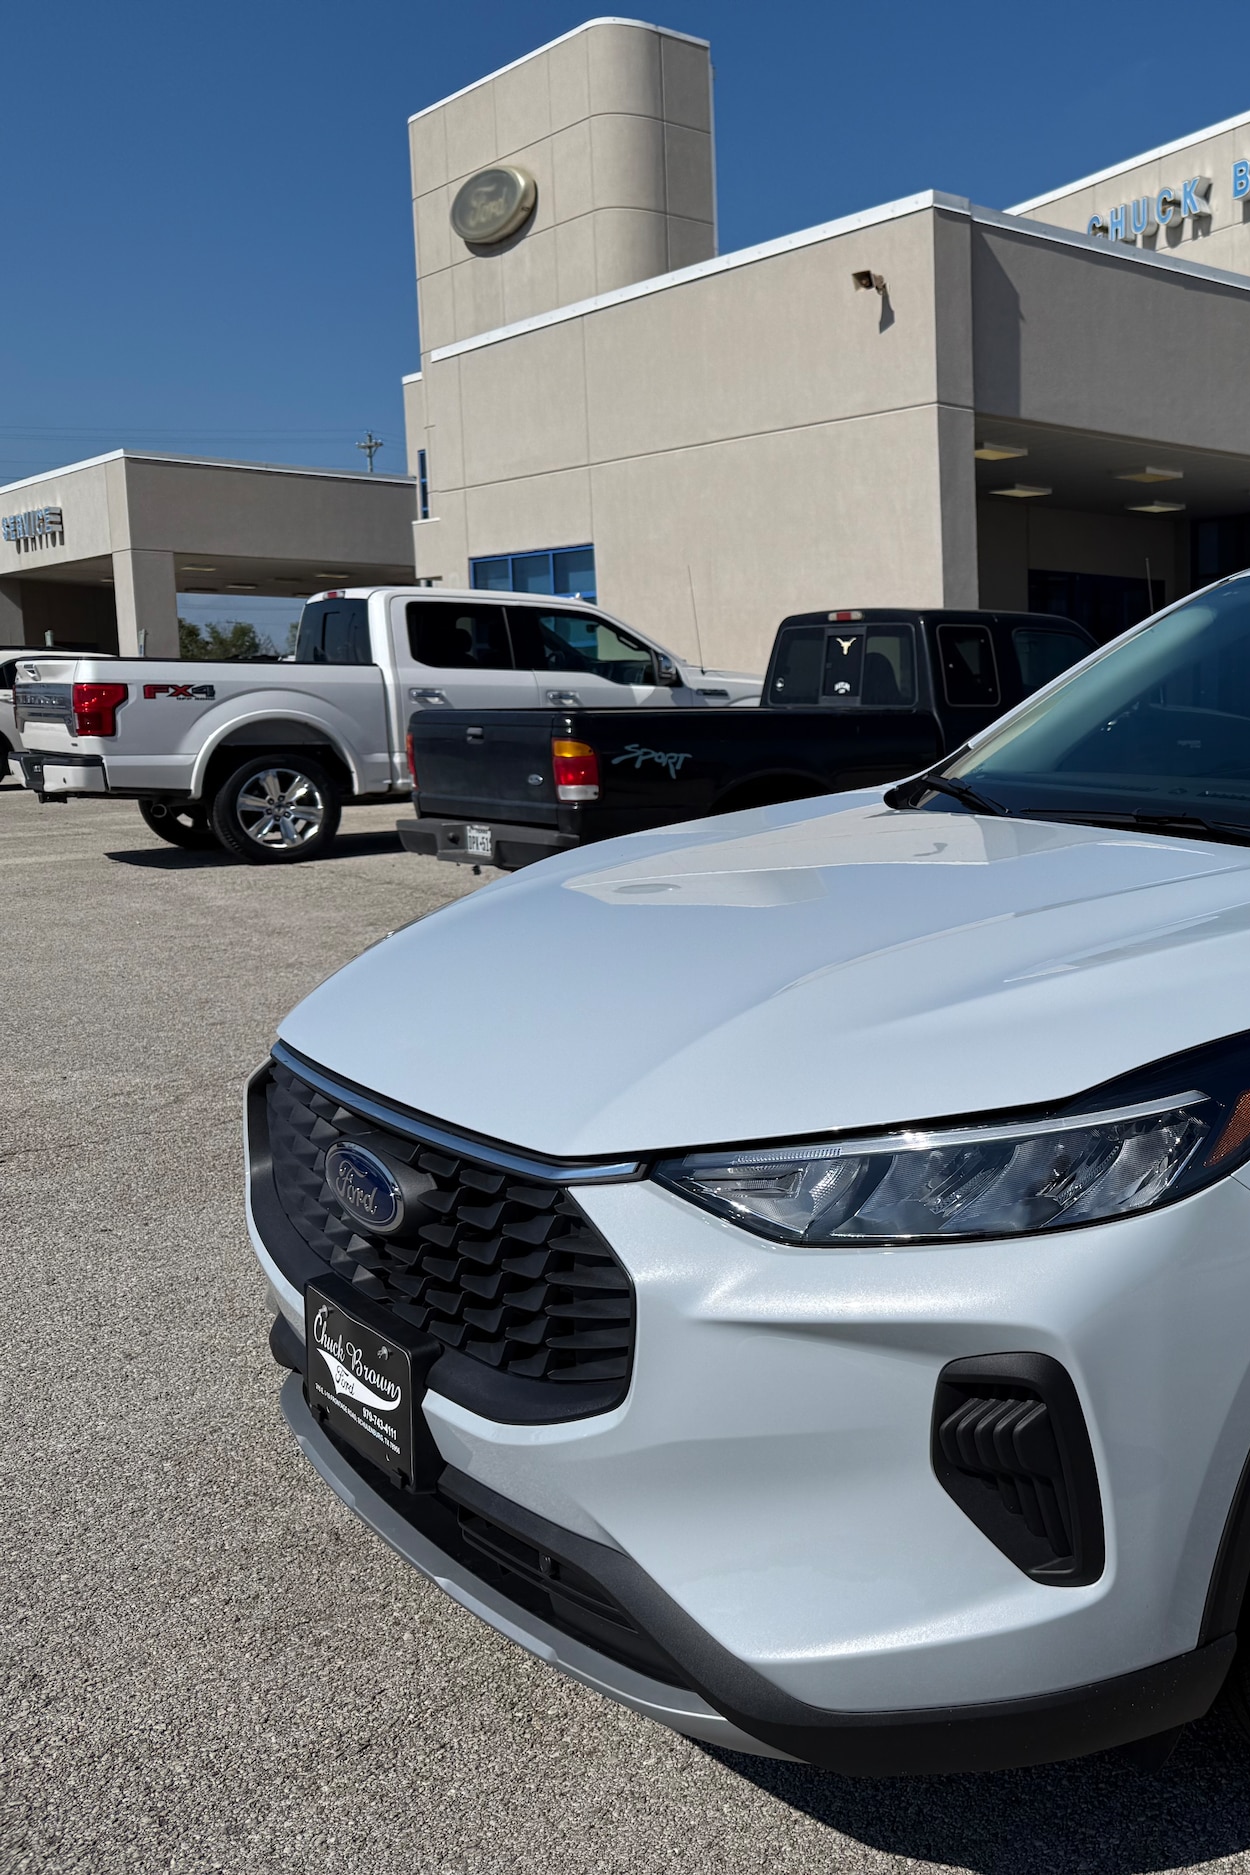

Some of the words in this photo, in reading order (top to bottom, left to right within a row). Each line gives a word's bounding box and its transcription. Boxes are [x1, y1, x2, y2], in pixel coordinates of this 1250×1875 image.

[1087, 176, 1206, 241] CHUCK
[2, 506, 59, 541] SERVICE
[143, 684, 215, 699] FX4
[611, 743, 693, 780] SPORT
[336, 1160, 378, 1215] Ford
[314, 1312, 346, 1362] Chuck
[346, 1342, 401, 1399] Brown
[335, 1365, 355, 1396] Ford
[362, 1406, 397, 1441] 979-743-4111
